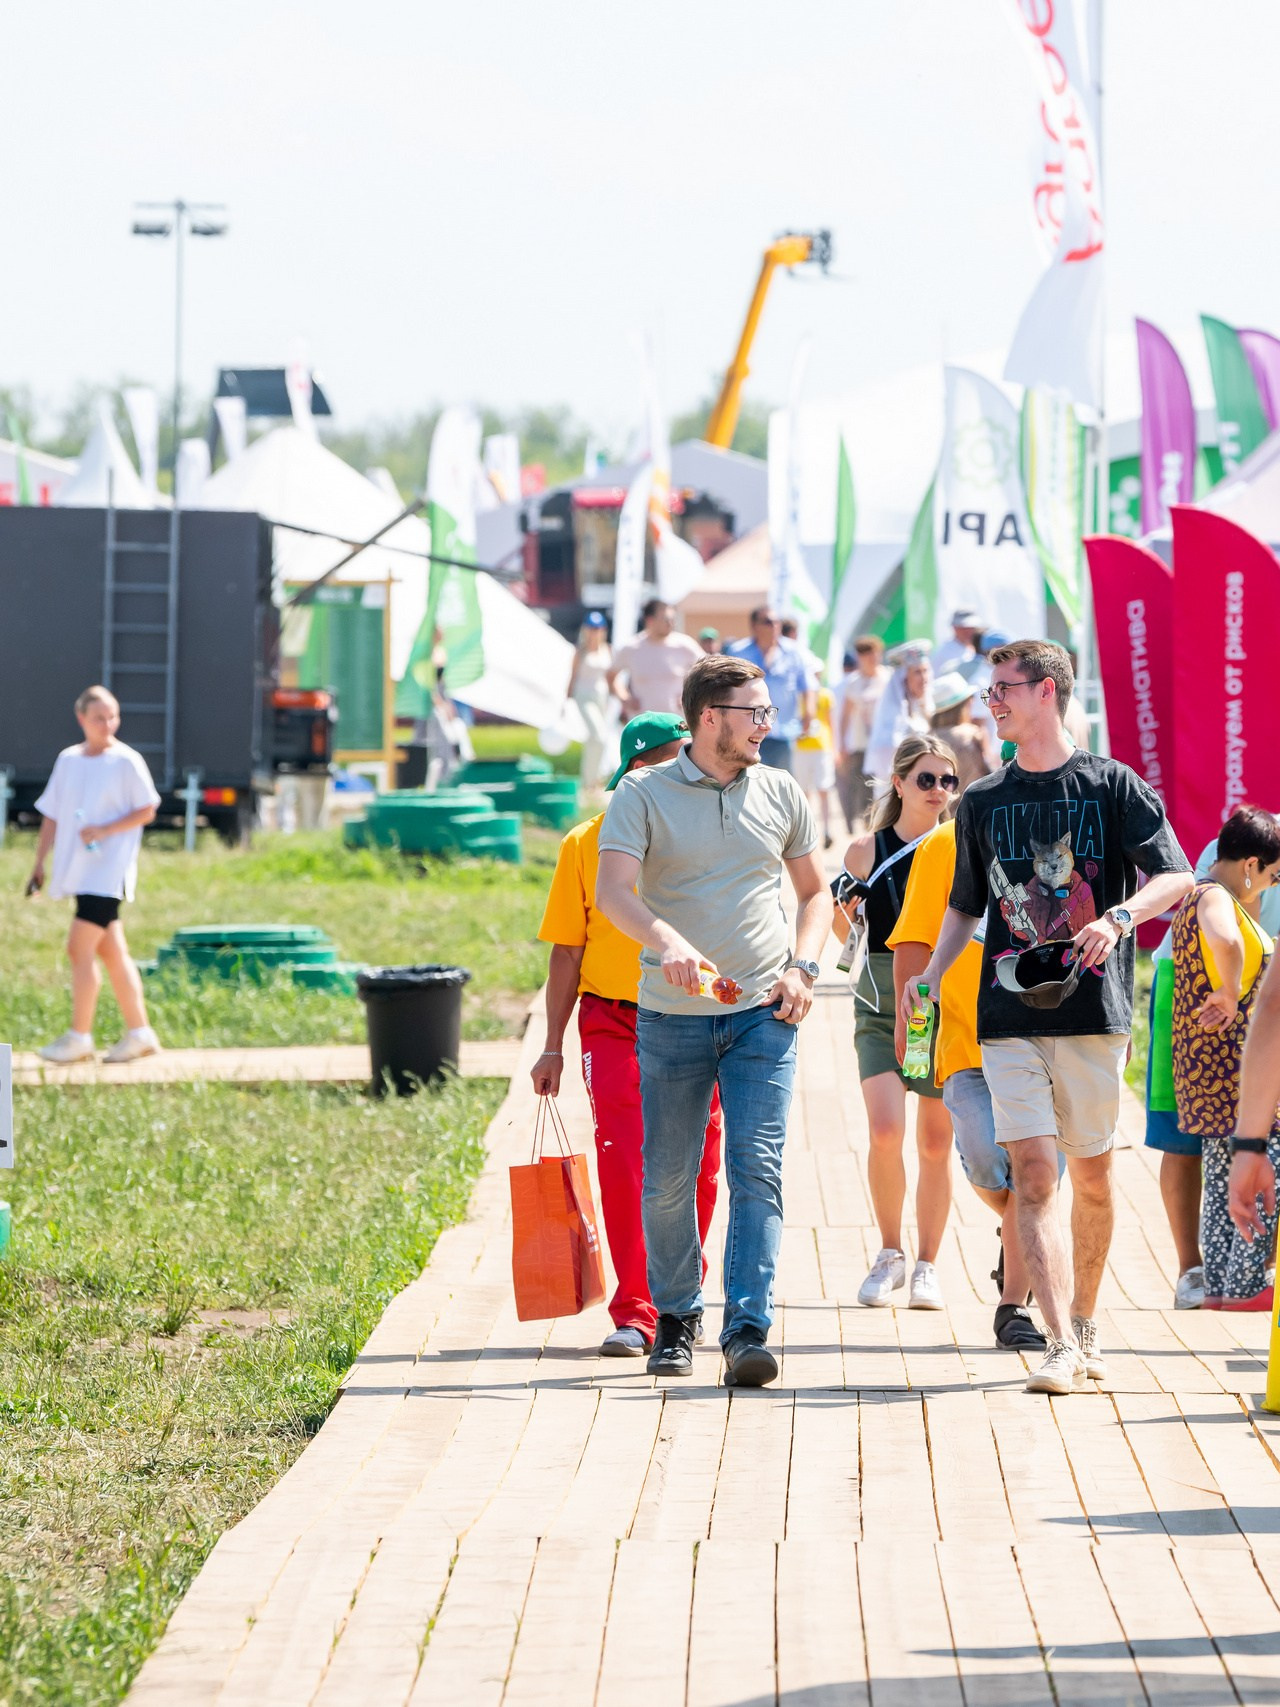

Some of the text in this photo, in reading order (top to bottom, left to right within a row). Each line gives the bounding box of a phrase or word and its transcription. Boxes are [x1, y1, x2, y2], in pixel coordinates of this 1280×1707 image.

[1224, 571, 1247, 661] рисков
[1224, 664, 1243, 696] от
[991, 800, 1104, 861] AKITA
